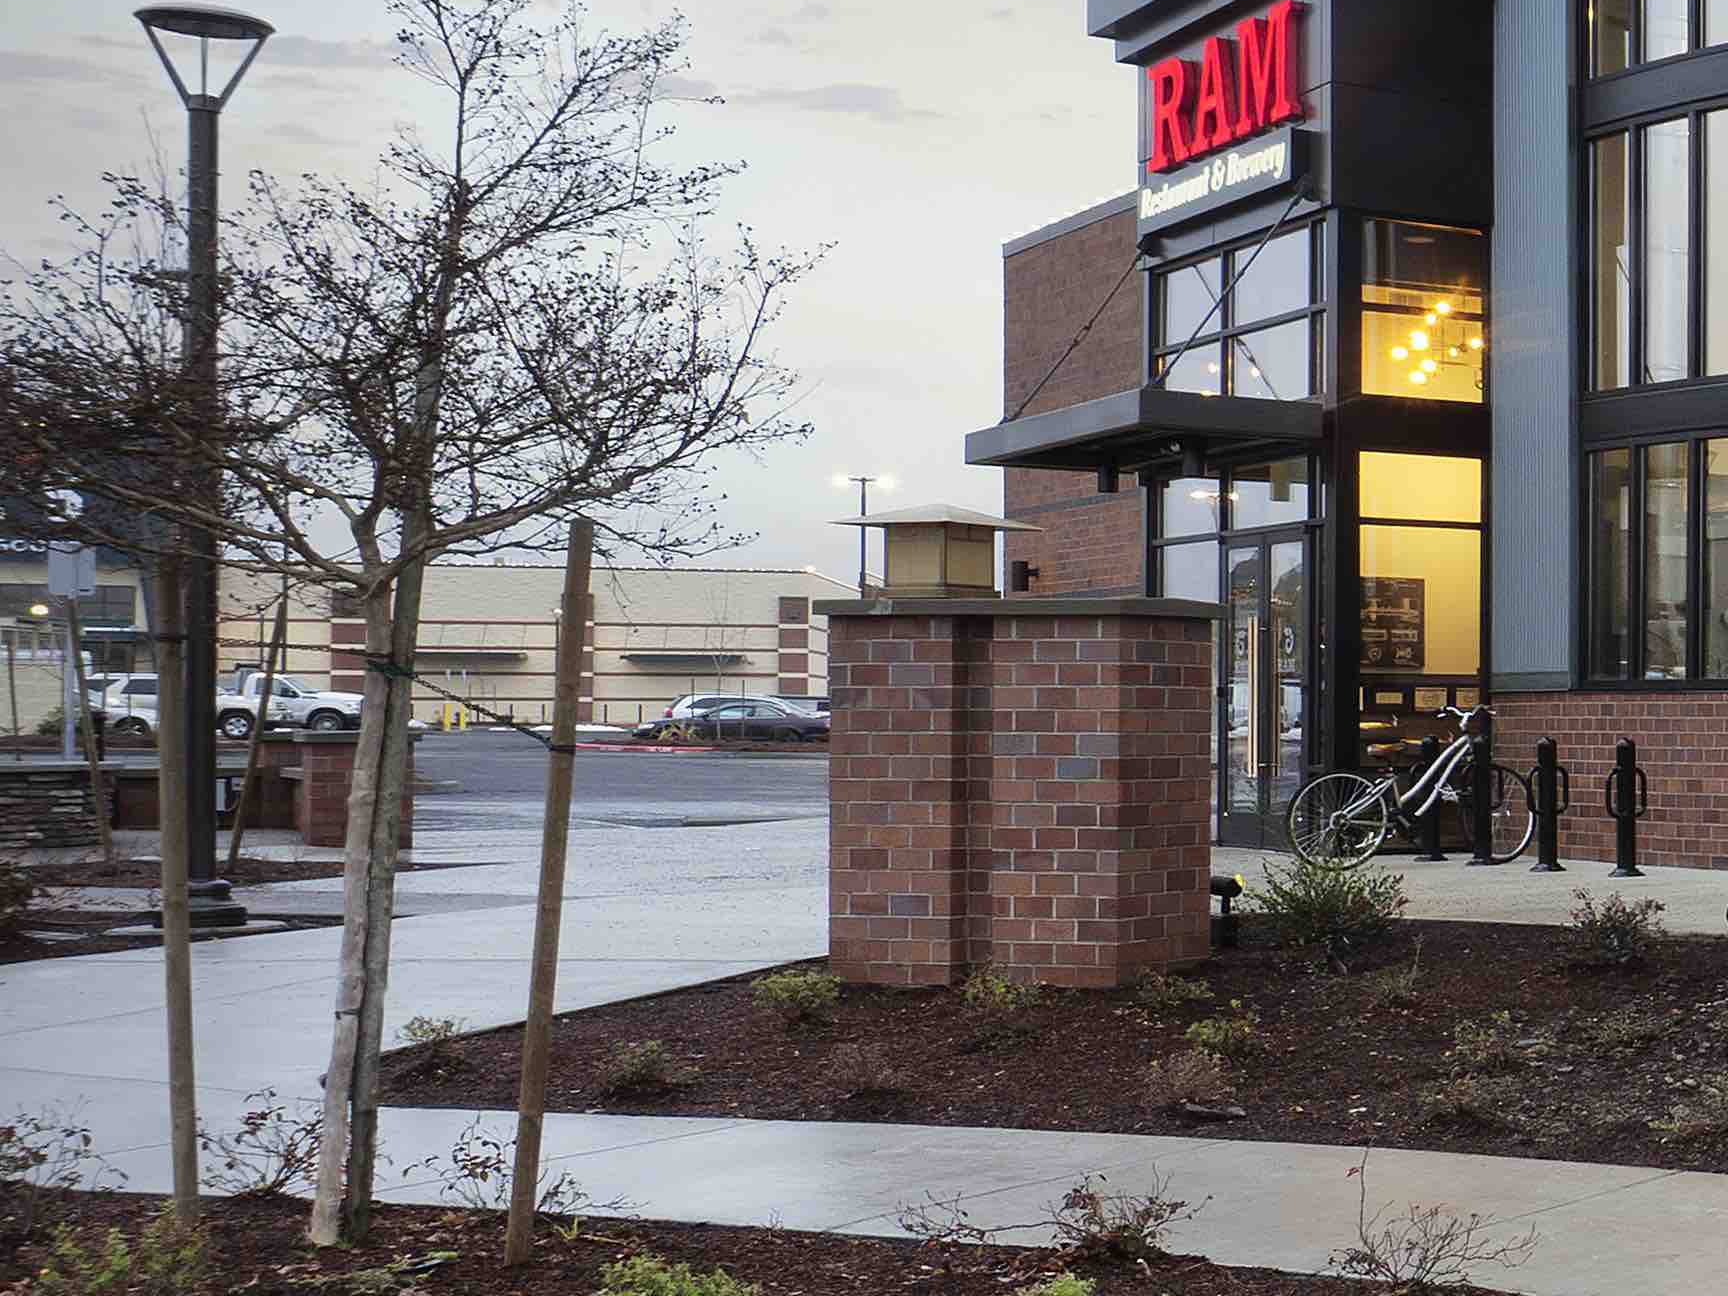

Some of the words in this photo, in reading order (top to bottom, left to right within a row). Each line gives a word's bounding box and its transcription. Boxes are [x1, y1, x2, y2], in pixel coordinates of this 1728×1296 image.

[1146, 0, 1308, 174] RAM
[1139, 165, 1210, 219] Restaurant
[1210, 158, 1226, 192] &
[1226, 145, 1286, 188] Brewery
